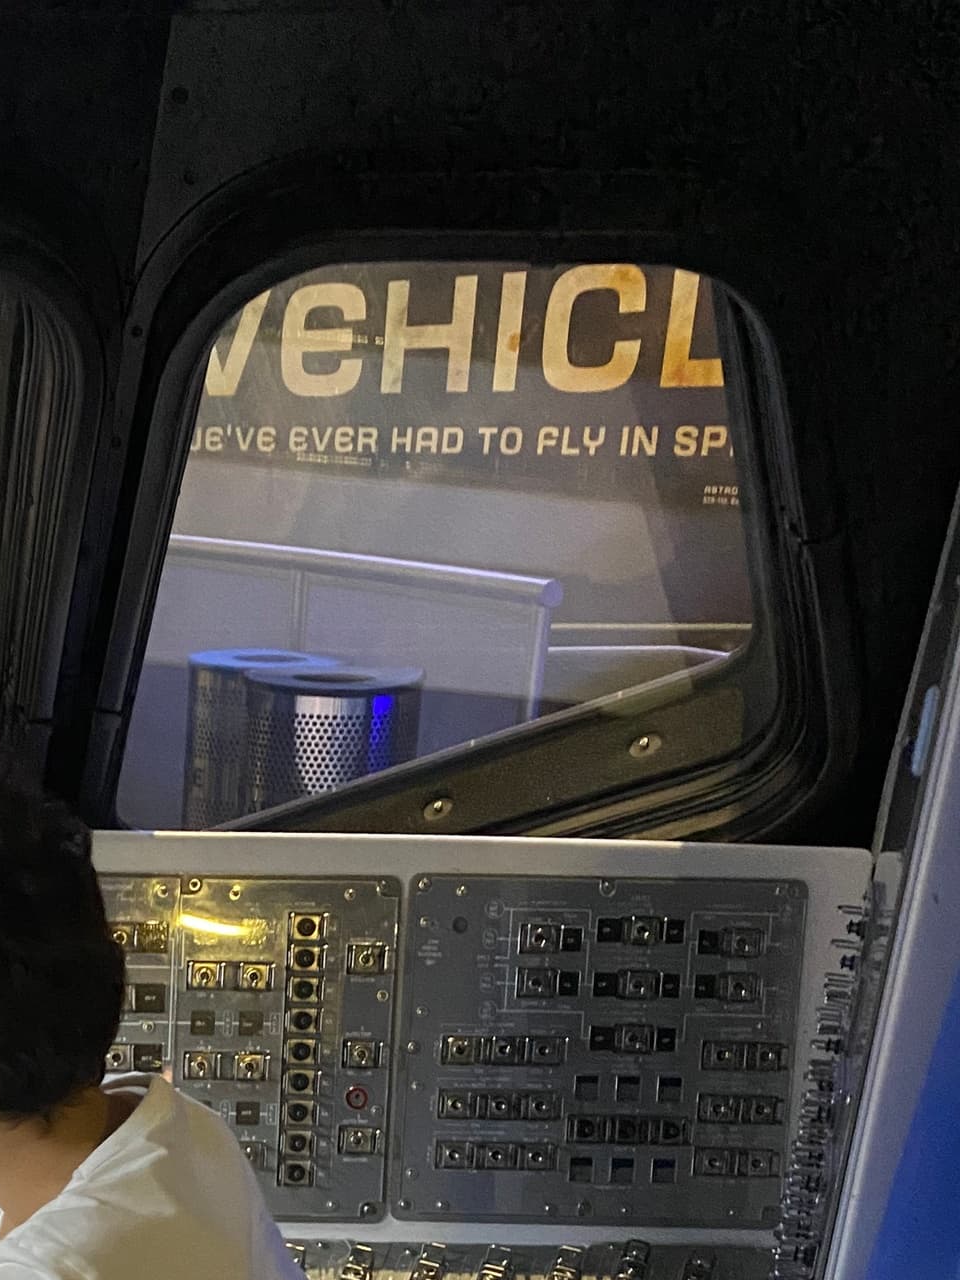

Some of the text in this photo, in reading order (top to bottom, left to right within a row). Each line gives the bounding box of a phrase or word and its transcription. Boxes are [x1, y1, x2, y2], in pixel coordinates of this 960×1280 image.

[205, 263, 725, 397] VEHICL
[289, 425, 379, 454] EVER
[391, 425, 464, 455] HAD
[479, 425, 523, 456] TO
[537, 425, 606, 457] FLY
[620, 425, 660, 457] IN
[673, 425, 735, 458] SP
